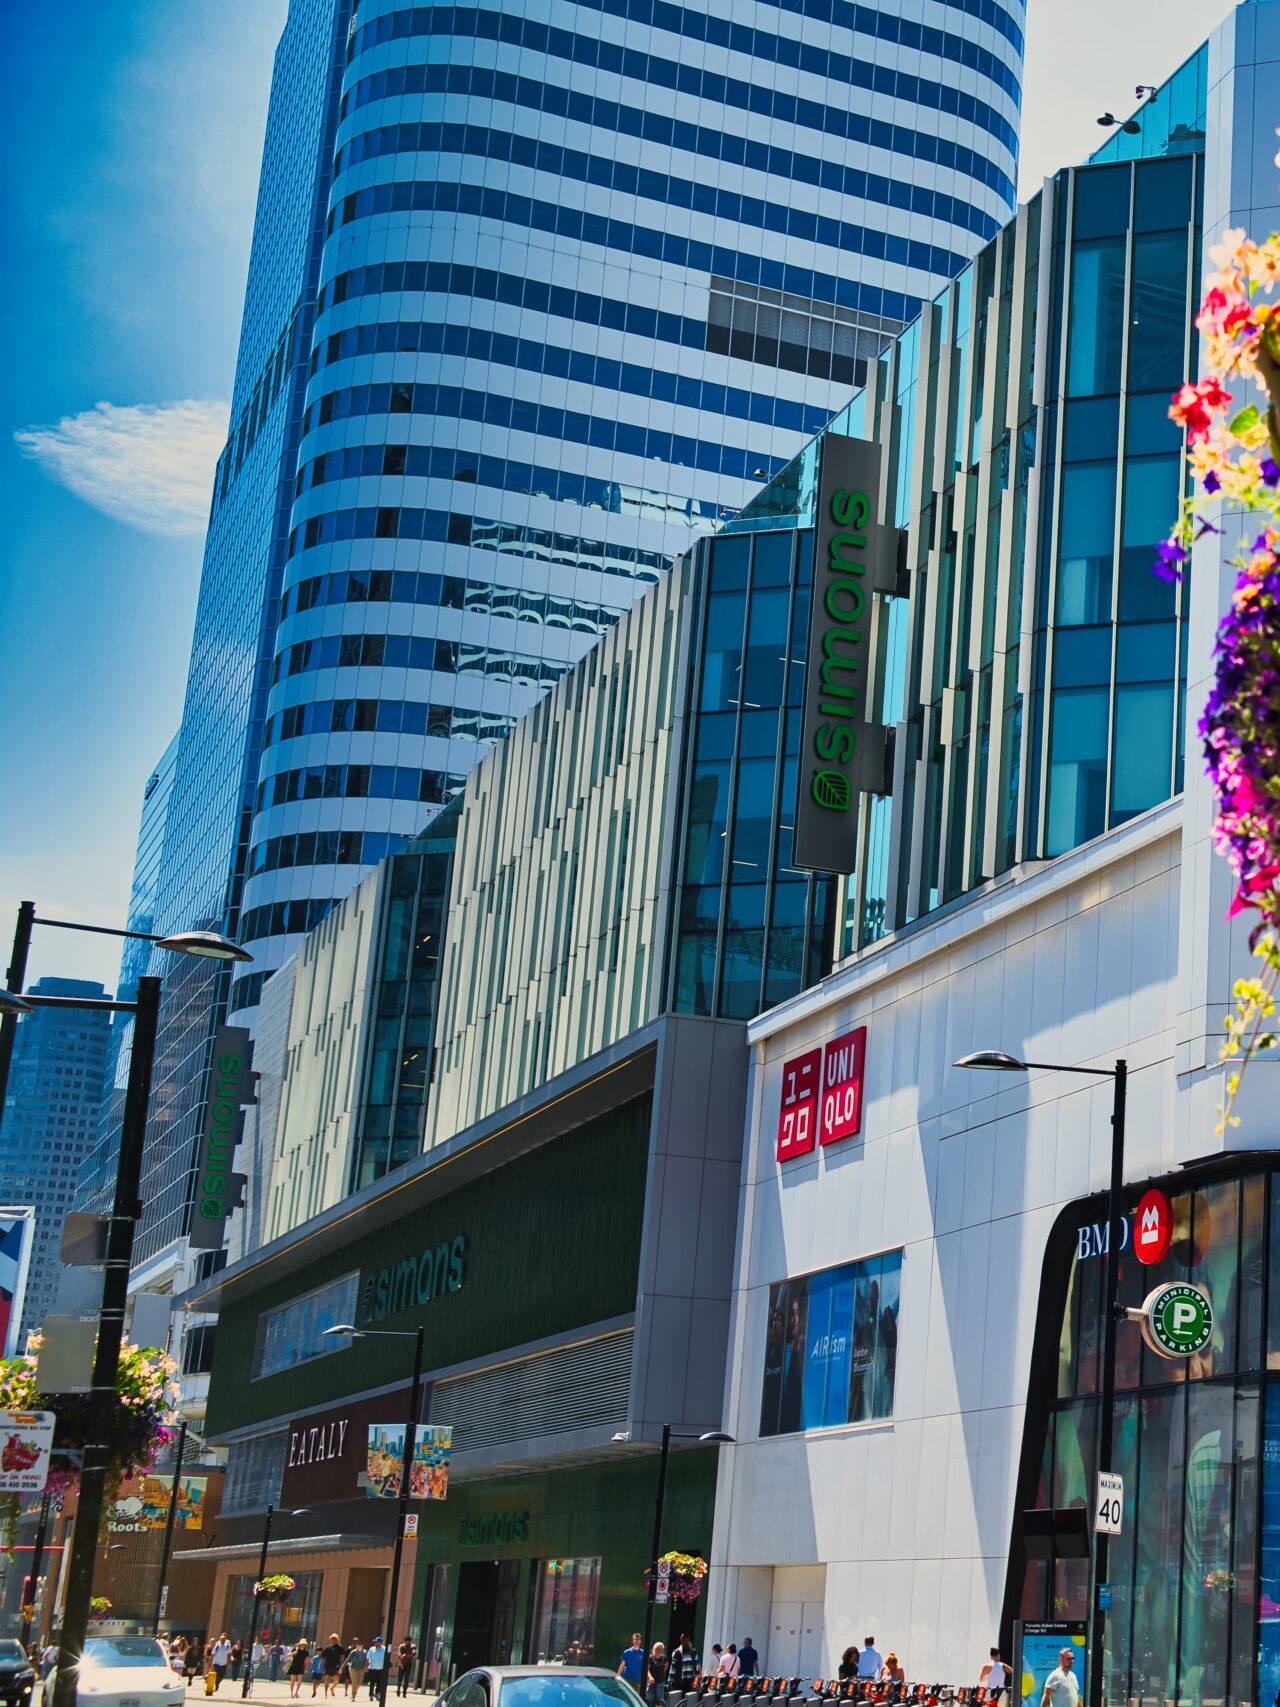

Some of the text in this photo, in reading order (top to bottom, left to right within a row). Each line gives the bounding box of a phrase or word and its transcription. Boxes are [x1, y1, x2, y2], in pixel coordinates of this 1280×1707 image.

[815, 487, 872, 765] simons
[827, 1044, 855, 1087] UNI
[203, 1054, 242, 1195] simons
[824, 1086, 855, 1135] QLO
[374, 1235, 465, 1322] simons
[1157, 1288, 1209, 1316] MUNICIPAL
[1172, 1302, 1198, 1330] P
[1155, 1322, 1209, 1352] PARKING
[288, 1420, 349, 1468] EATALY
[108, 1521, 148, 1533] Roots
[465, 1511, 526, 1546] simons
[1098, 1498, 1121, 1525] 40
